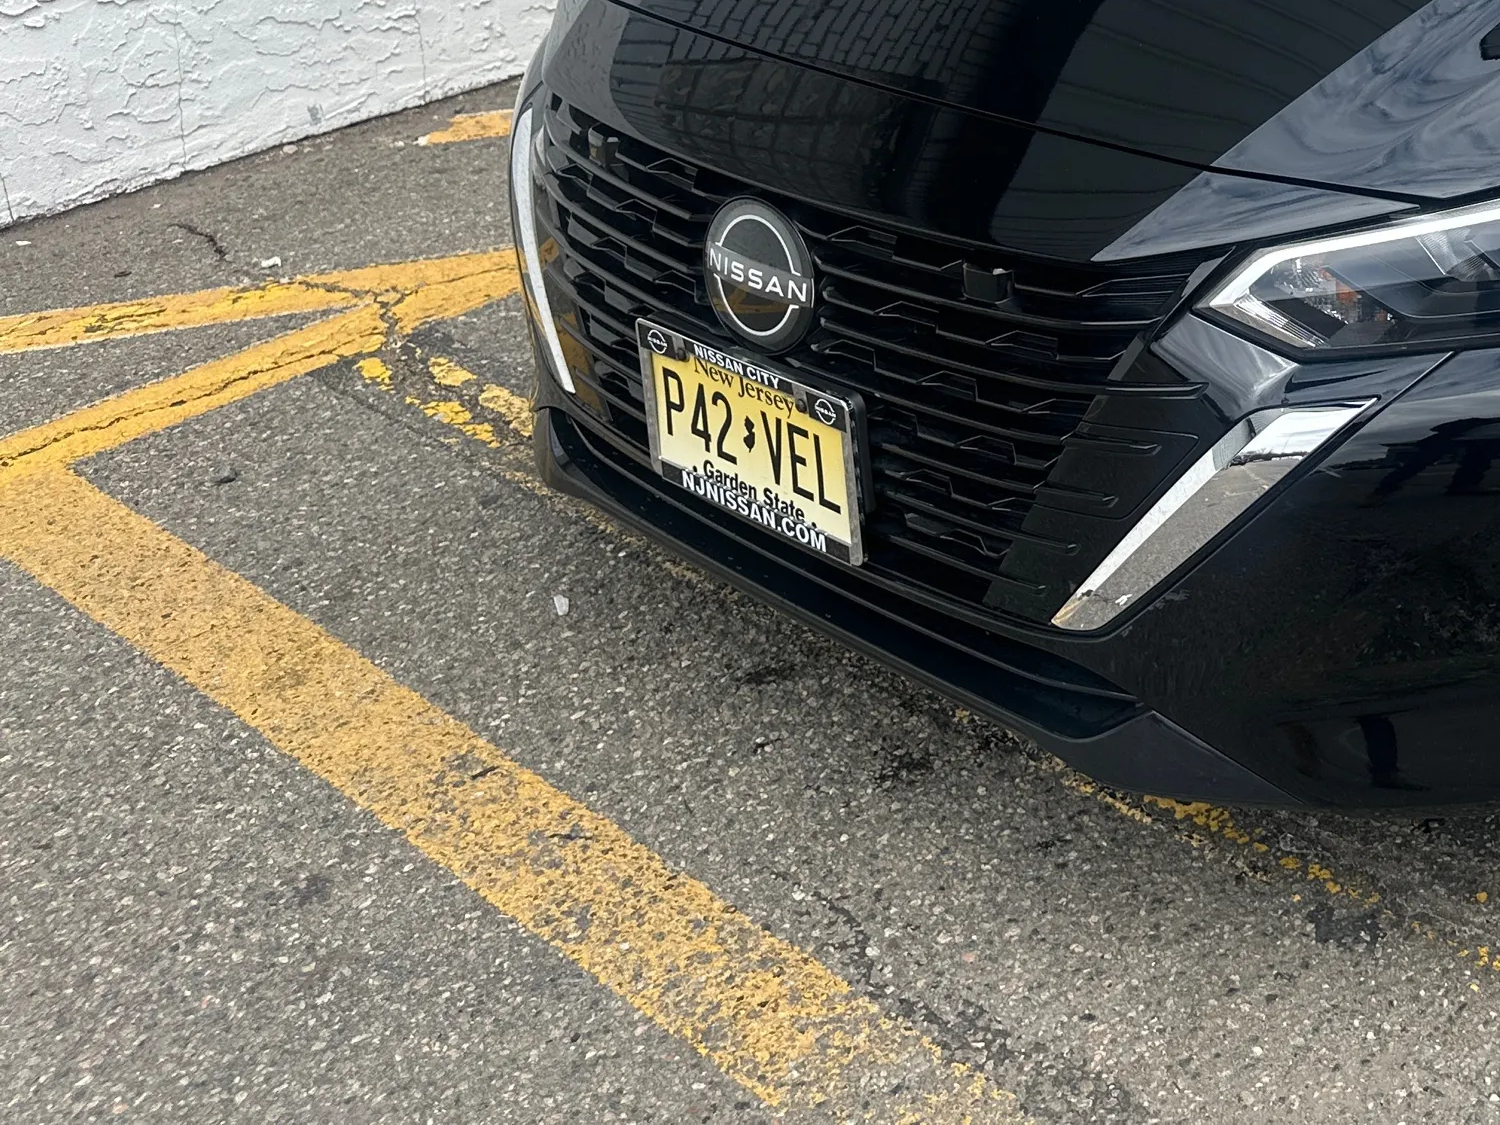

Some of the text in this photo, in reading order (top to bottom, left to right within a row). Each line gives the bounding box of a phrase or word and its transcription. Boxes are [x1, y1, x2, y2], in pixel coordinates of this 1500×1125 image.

[709, 247, 807, 302] NISSAN
[694, 343, 780, 389] NISSAN CITY
[694, 358, 796, 418] New Jersey
[662, 366, 841, 515] P42 VEL
[682, 470, 827, 552] NJNISSAN.COM
[703, 459, 805, 520] Garden State
